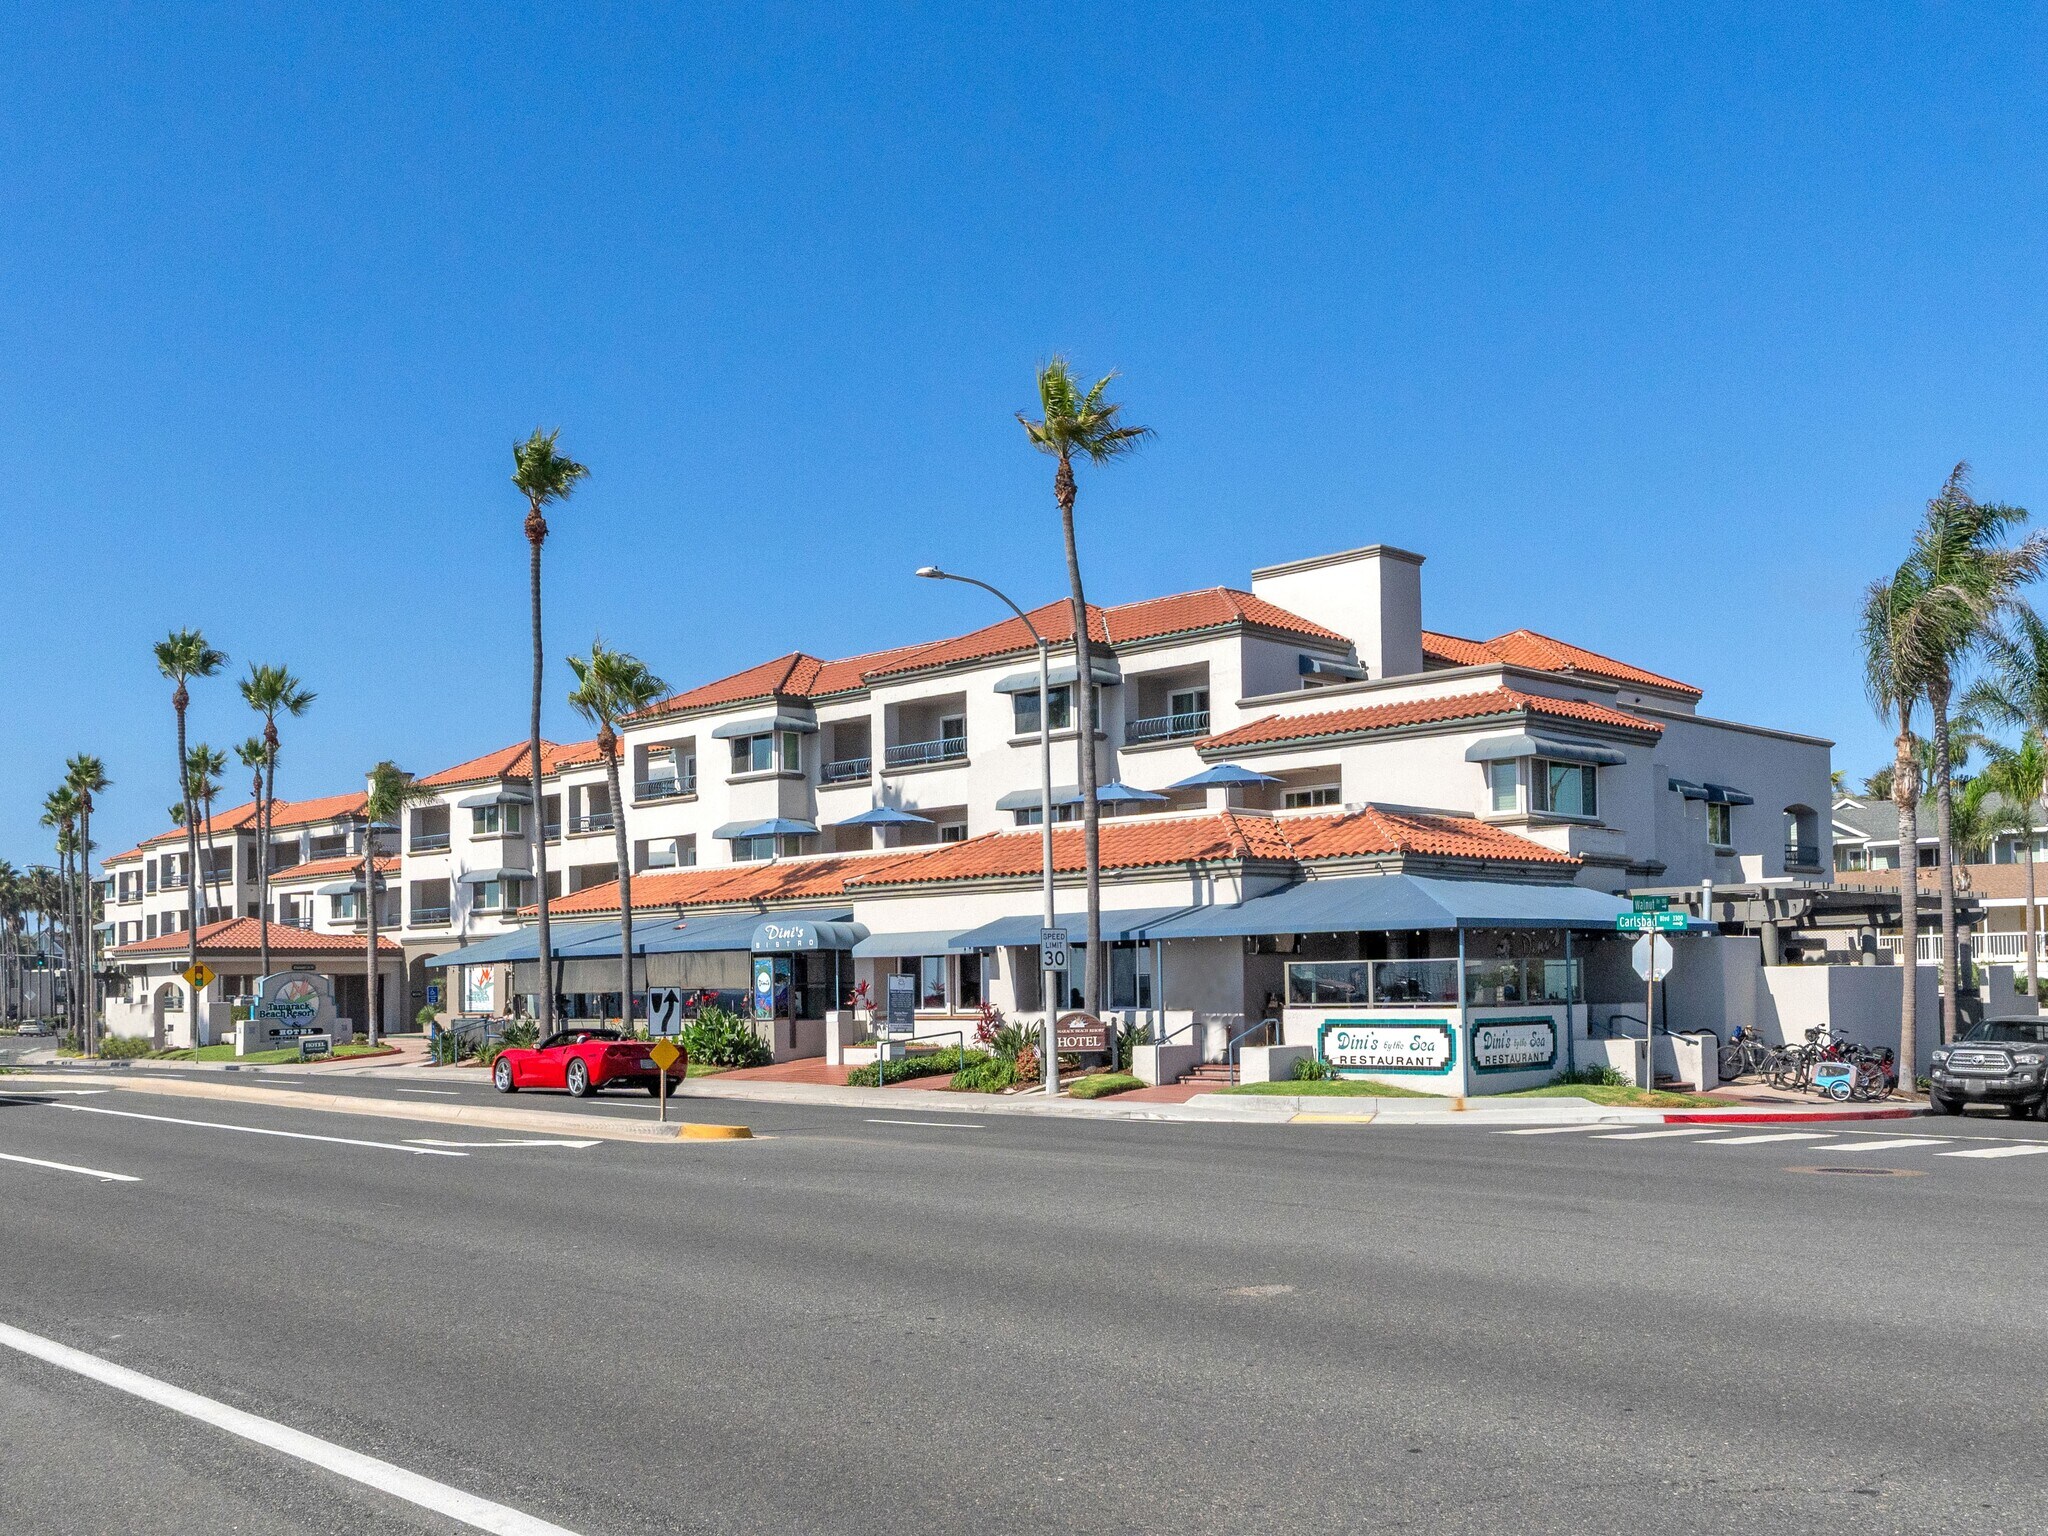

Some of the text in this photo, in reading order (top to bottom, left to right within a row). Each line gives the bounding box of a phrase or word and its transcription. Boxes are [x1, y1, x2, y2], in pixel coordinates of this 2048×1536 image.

[1635, 899, 1655, 911] Walnut
[1619, 916, 1658, 928] Carlsbad
[765, 924, 804, 940] Dini's
[755, 939, 814, 949] BISTRO
[1044, 951, 1065, 966] 30
[268, 1003, 310, 1011] Tamarack
[260, 1010, 315, 1018] Beach Resort
[1057, 1036, 1102, 1048] HOTEL
[1337, 1031, 1379, 1050] Dini's
[1409, 1035, 1435, 1051] Sea
[1483, 1030, 1511, 1050] Dini's
[1530, 1031, 1546, 1047] Sea
[1339, 1055, 1434, 1066] RESTAURANT
[1485, 1053, 1545, 1064] RESTAURANT
